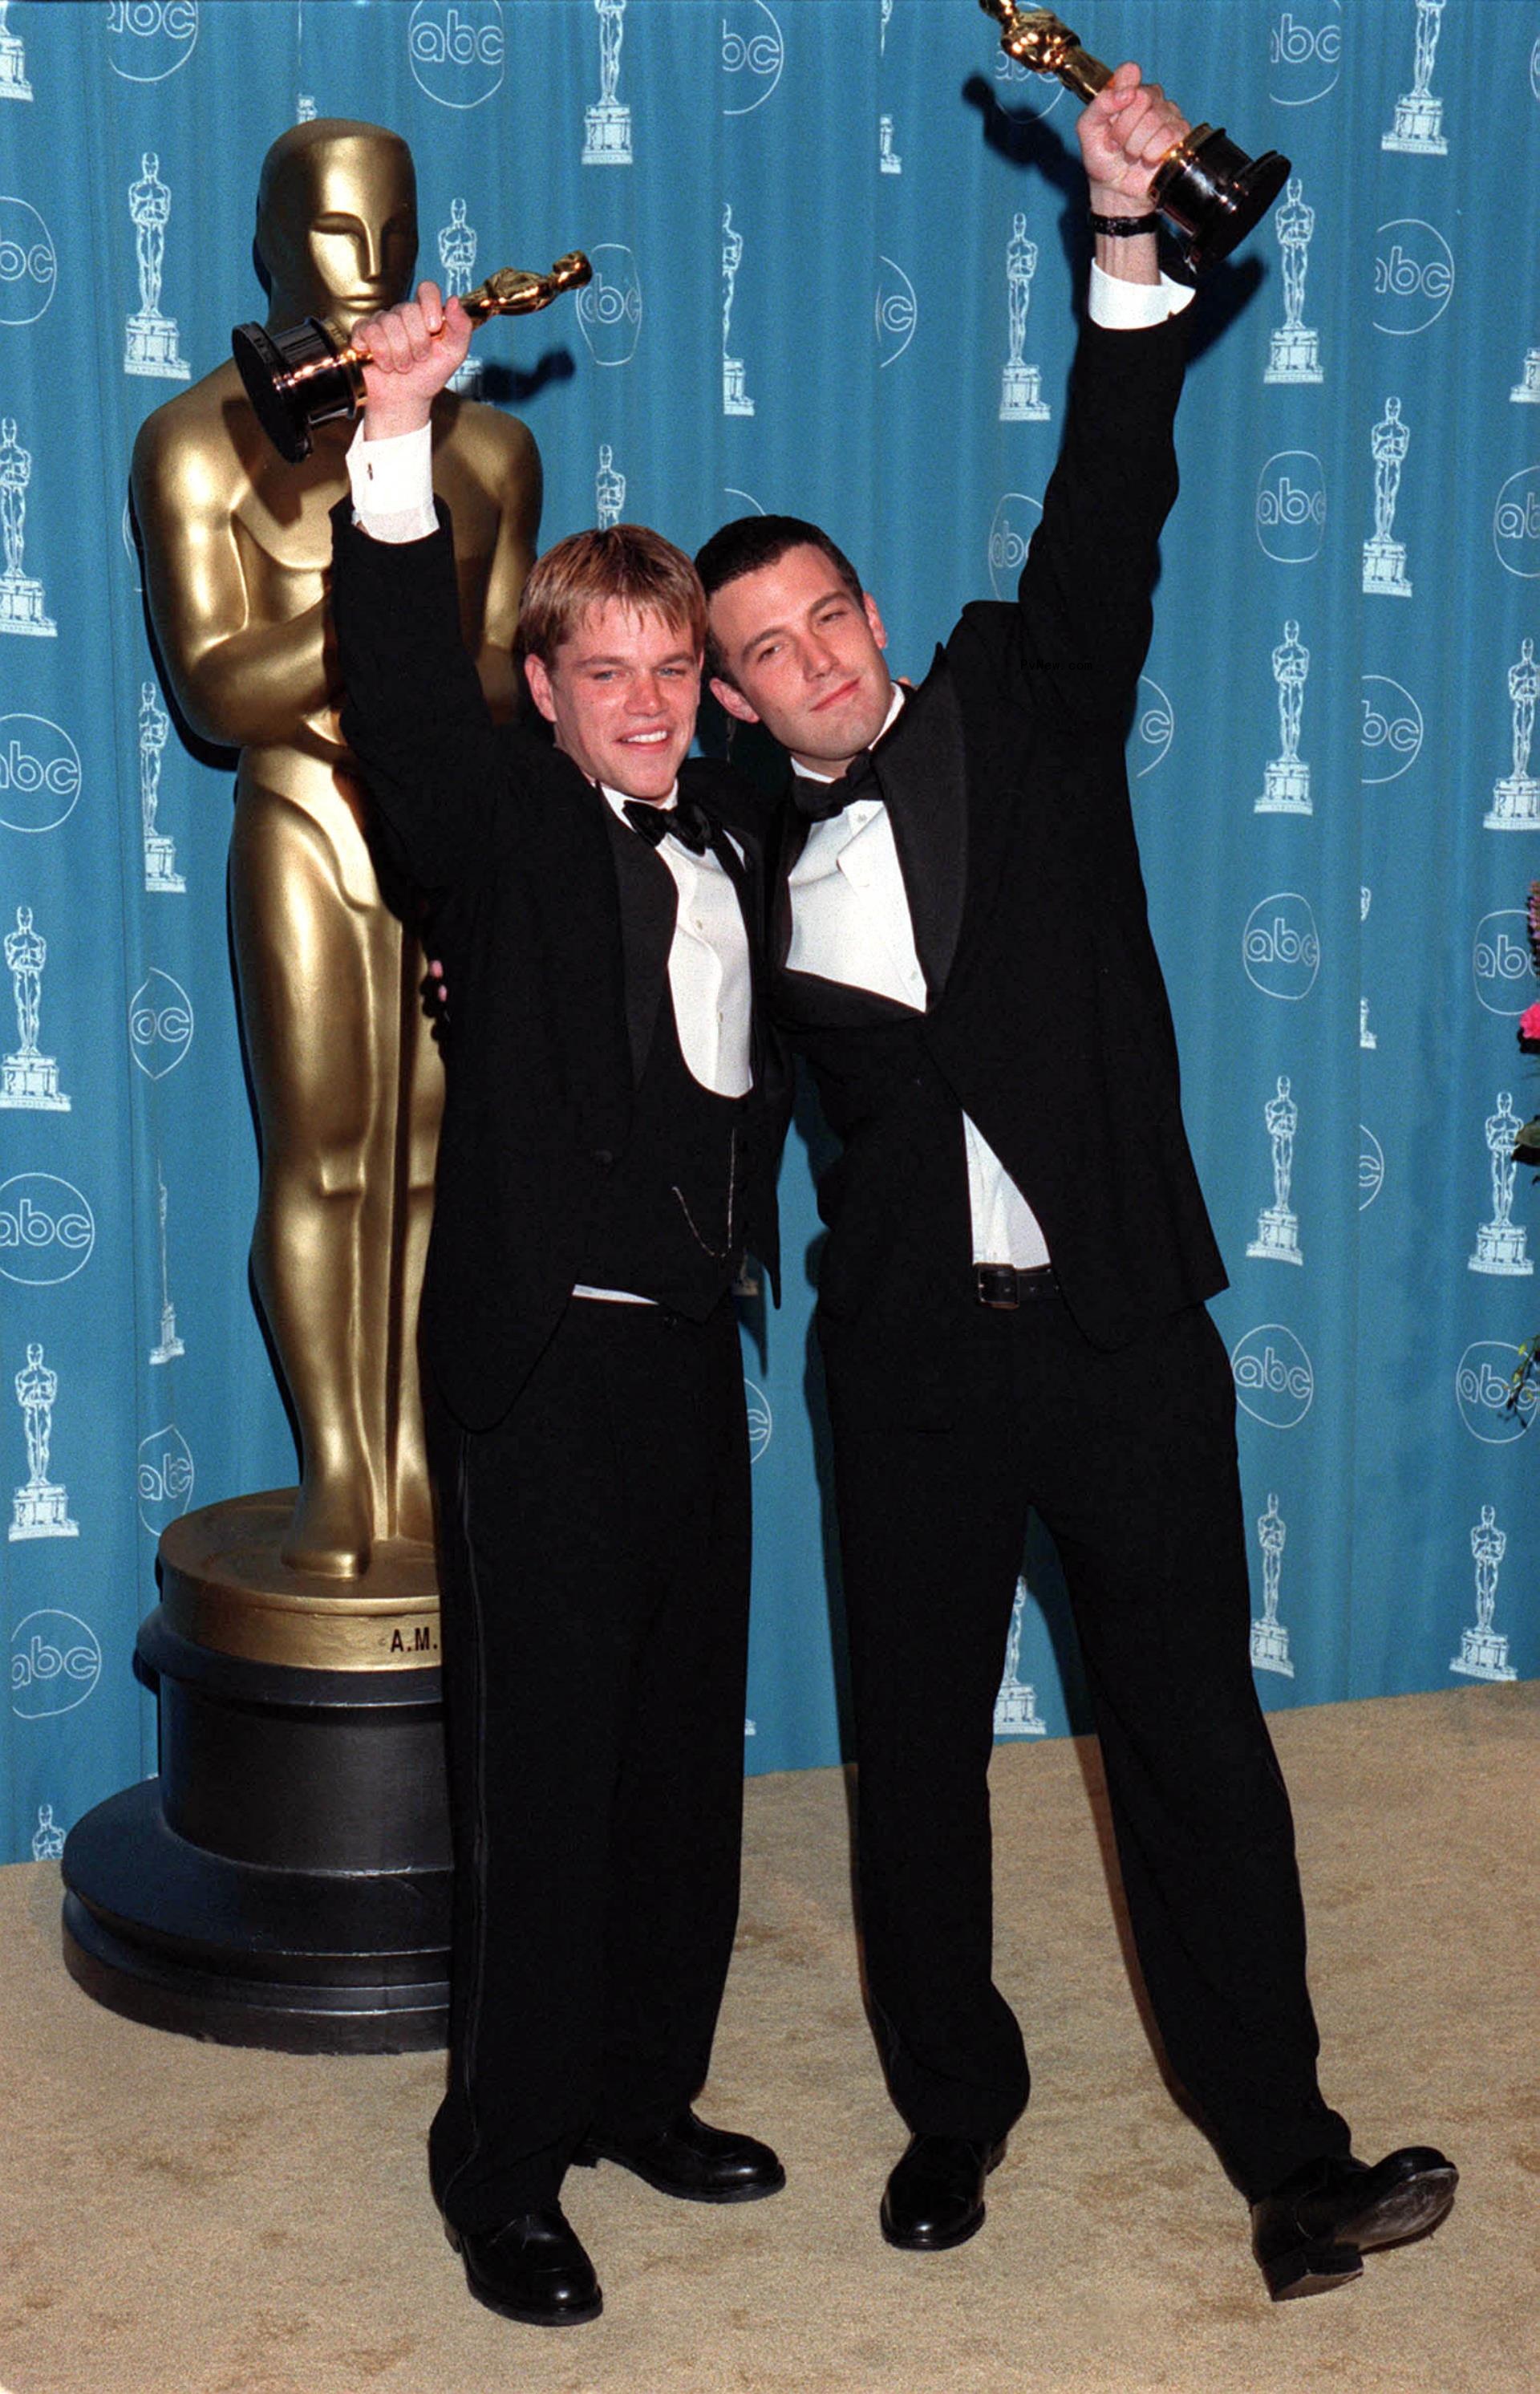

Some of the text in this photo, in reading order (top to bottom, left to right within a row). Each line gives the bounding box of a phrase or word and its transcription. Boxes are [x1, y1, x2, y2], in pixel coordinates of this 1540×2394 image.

[410, 10, 504, 64] abc
[1245, 919, 1317, 967] abc
[1477, 935, 1537, 980] ab
[1234, 1346, 1311, 1398] abc
